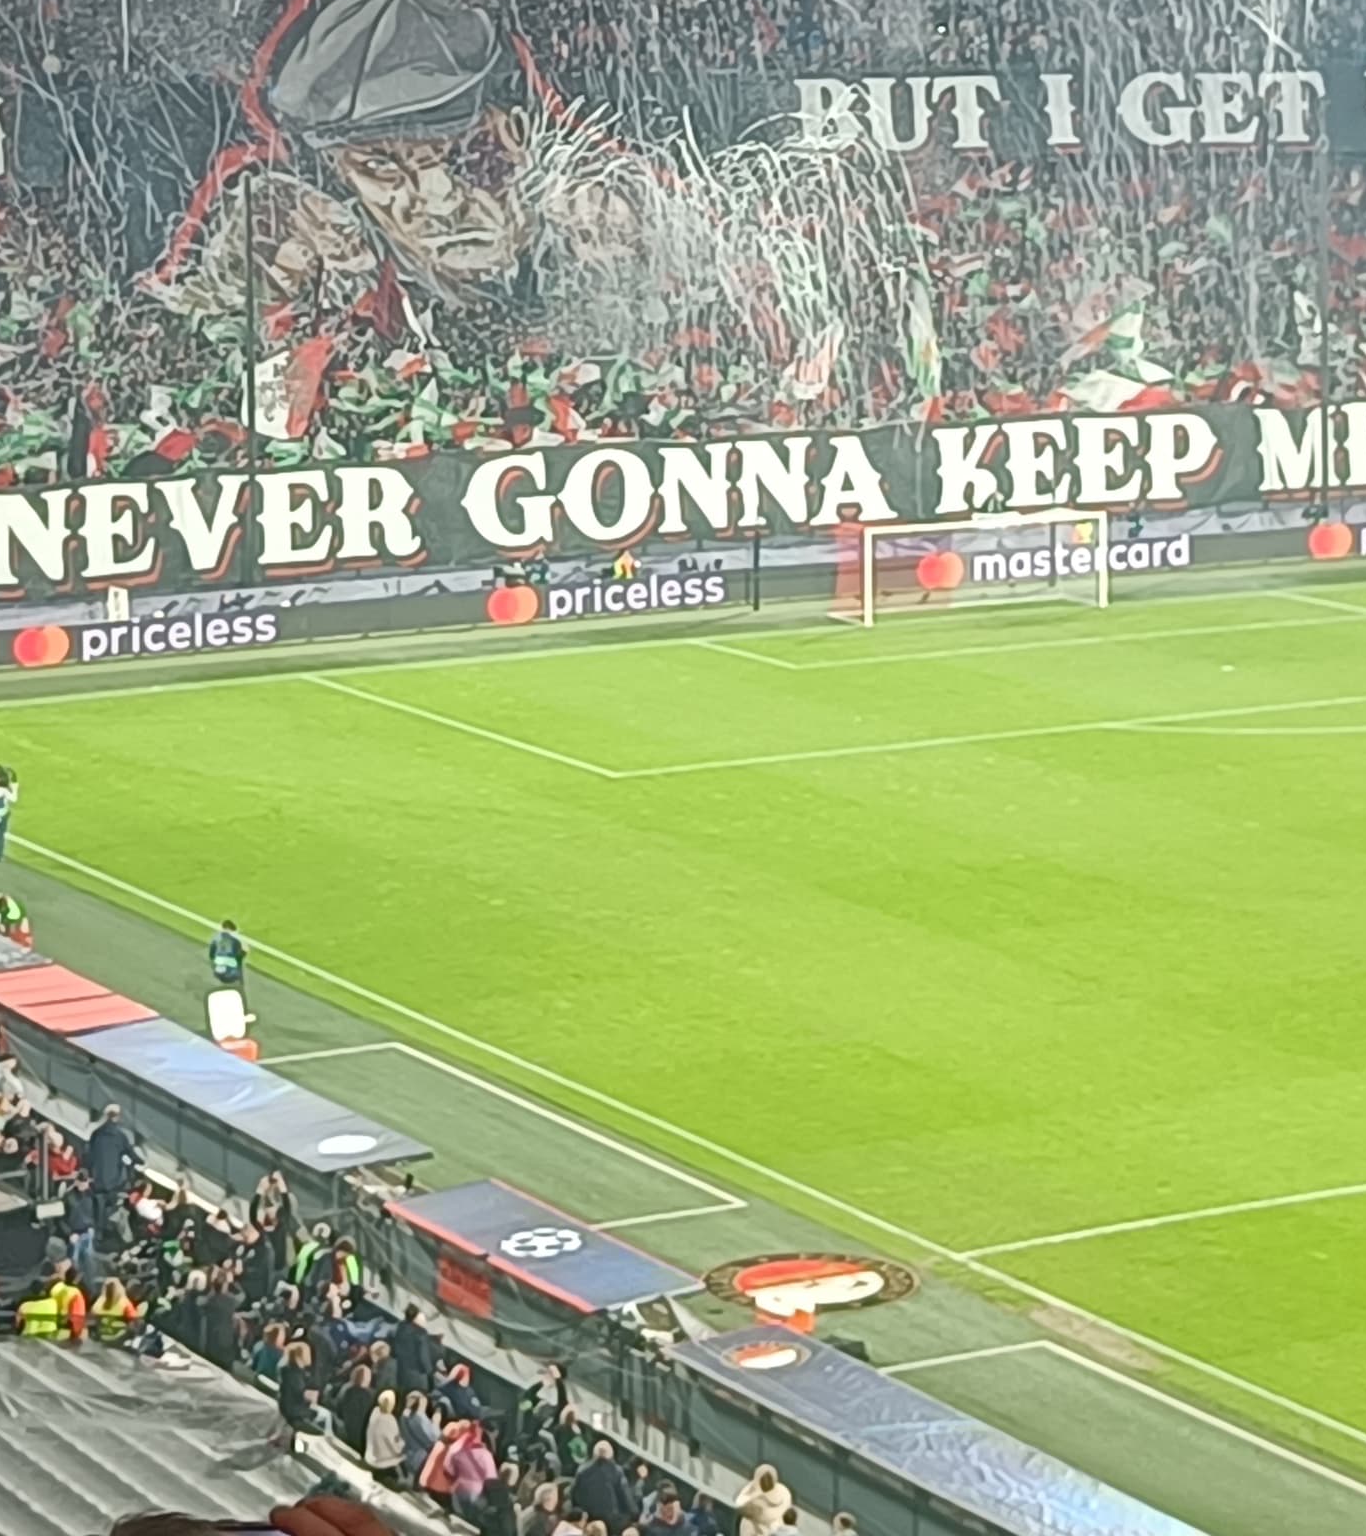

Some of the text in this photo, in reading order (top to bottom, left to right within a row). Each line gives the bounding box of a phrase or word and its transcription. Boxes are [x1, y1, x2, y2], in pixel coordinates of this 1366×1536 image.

[795, 75, 1001, 152] BUT
[1039, 73, 1080, 145] I
[1118, 71, 1326, 146] GET
[462, 437, 897, 549] GONNA
[932, 414, 1220, 514] KEEP
[972, 534, 1191, 581] mastercard
[547, 572, 725, 620] priceless
[81, 609, 278, 660] priceless
